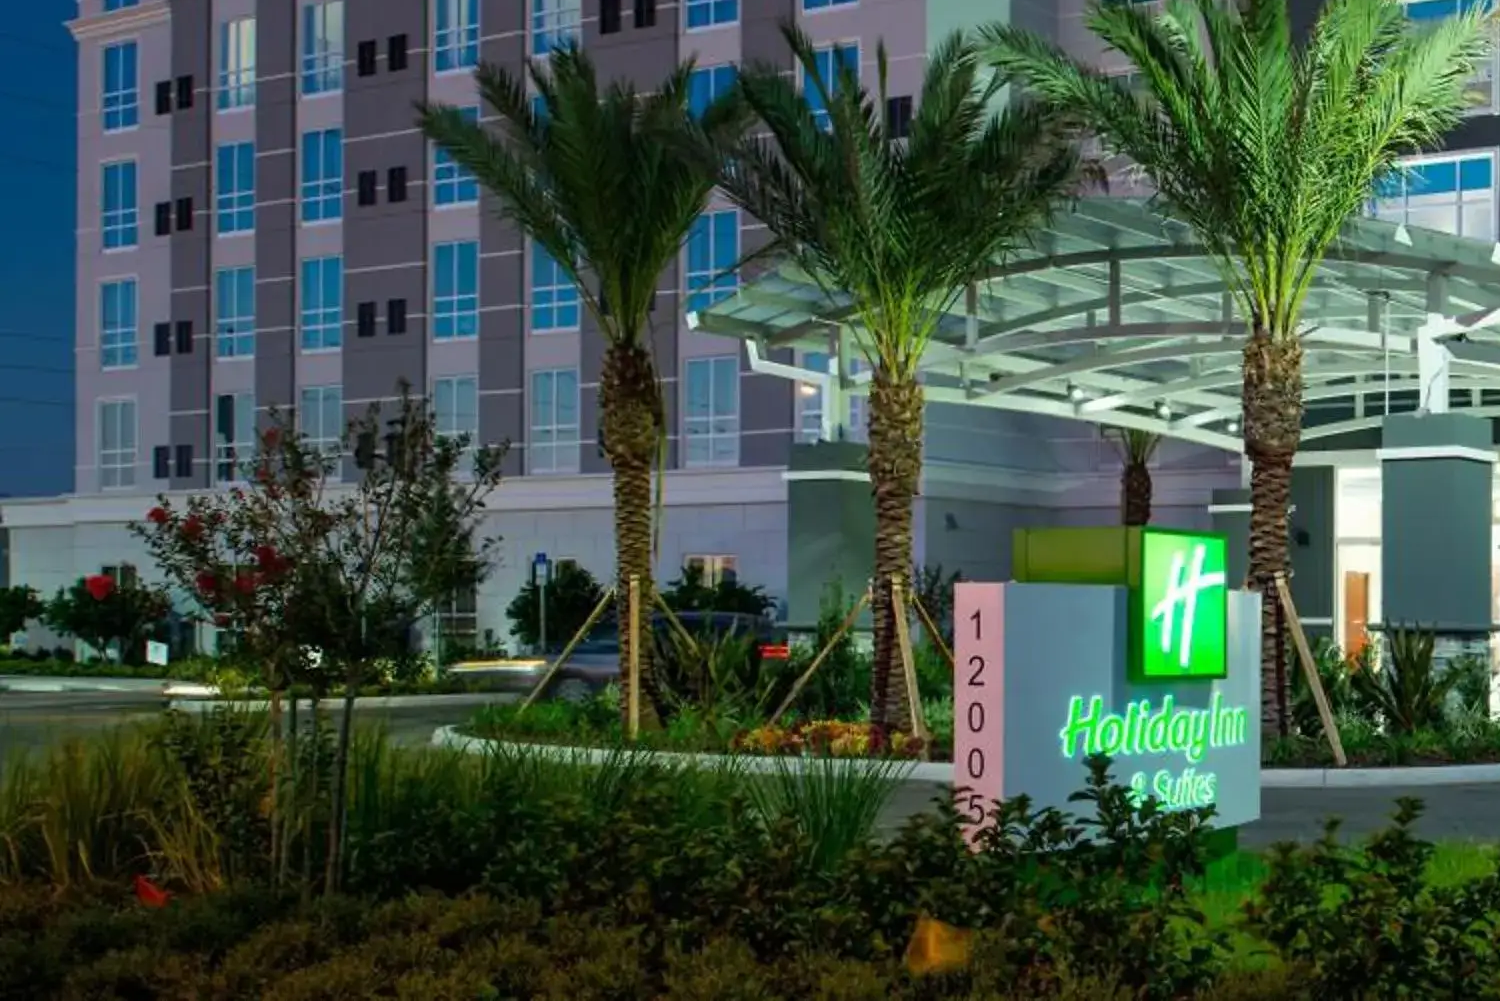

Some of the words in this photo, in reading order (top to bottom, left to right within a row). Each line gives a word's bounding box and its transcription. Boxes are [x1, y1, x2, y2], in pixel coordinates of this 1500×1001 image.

[1059, 693, 1210, 763] Holiday
[1209, 691, 1247, 747] Inn
[1153, 767, 1217, 809] Suites
